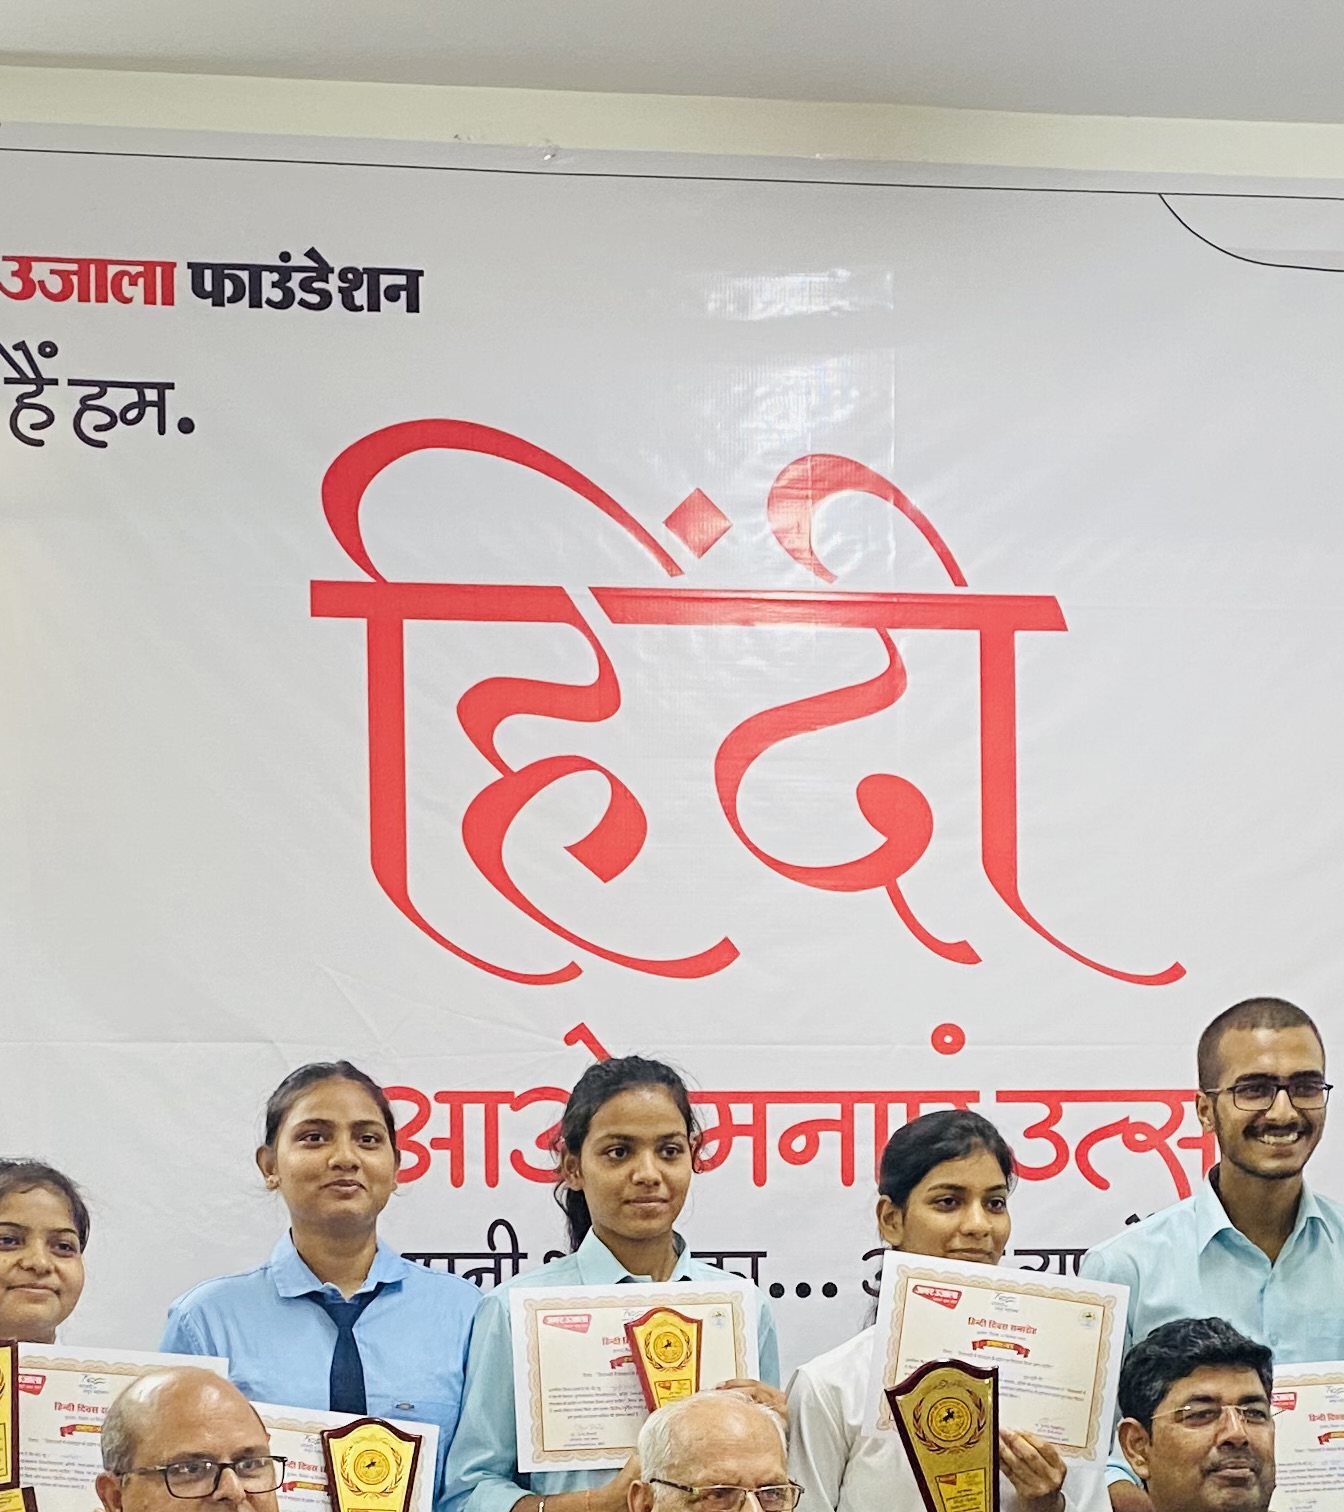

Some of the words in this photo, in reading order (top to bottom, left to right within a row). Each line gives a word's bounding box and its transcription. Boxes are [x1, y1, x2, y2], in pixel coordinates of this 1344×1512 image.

[187, 247, 424, 313] फाउंडेशन
[67, 380, 196, 448] हम.
[310, 417, 1187, 988] हिंदी
